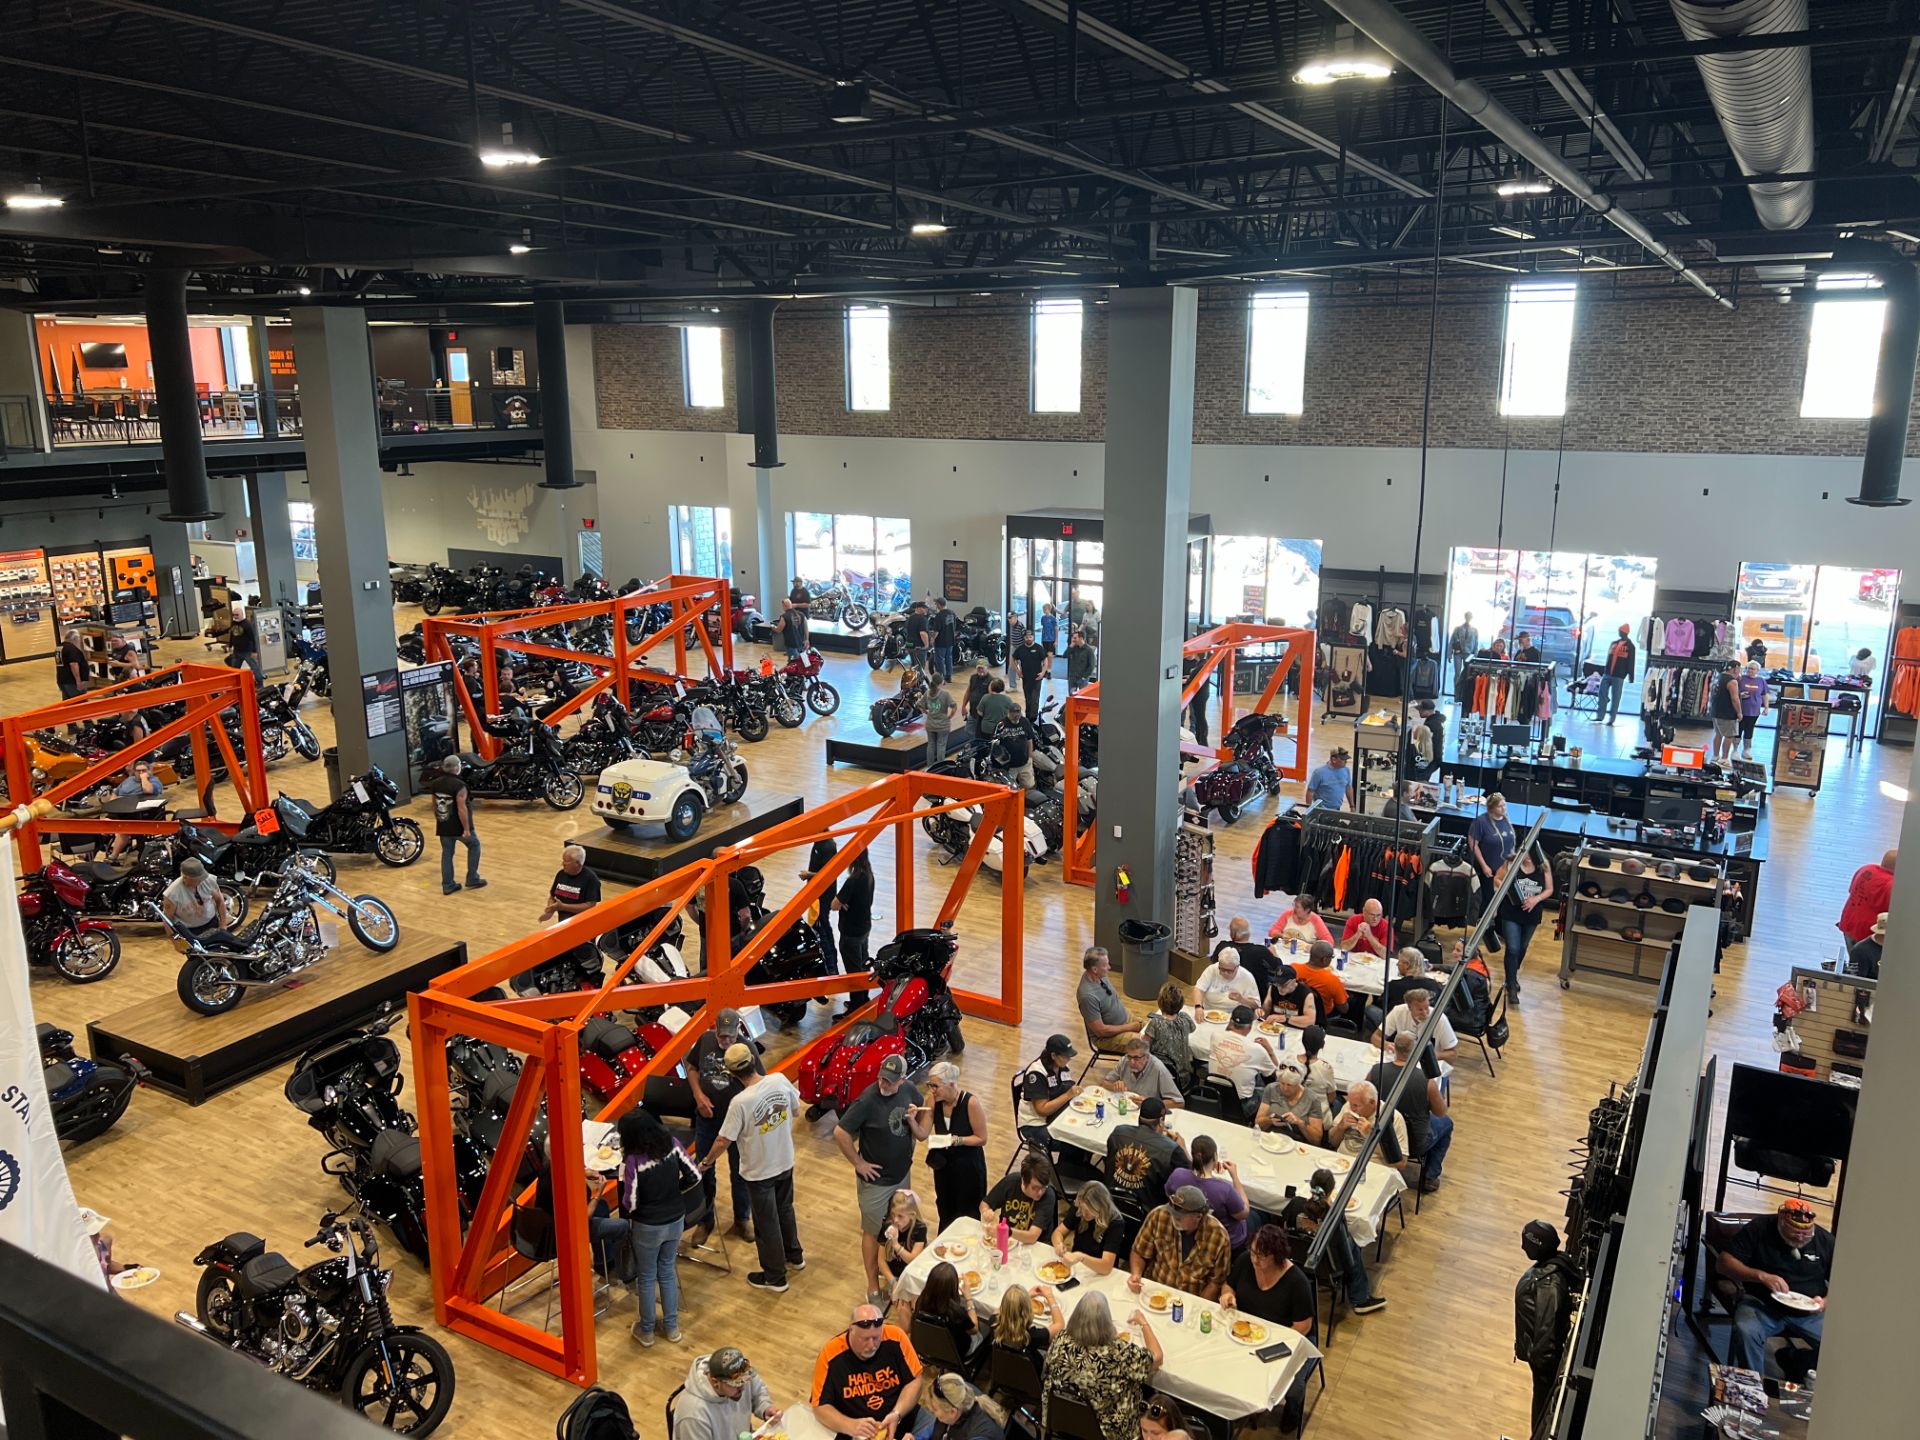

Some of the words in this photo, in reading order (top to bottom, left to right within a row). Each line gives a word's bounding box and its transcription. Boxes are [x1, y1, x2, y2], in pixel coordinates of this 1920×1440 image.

[257, 813, 274, 824] SALE
[1, 1085, 31, 1129] STA
[843, 1374, 901, 1399] DAVIDSON
[848, 1365, 894, 1387] HARLEY-
